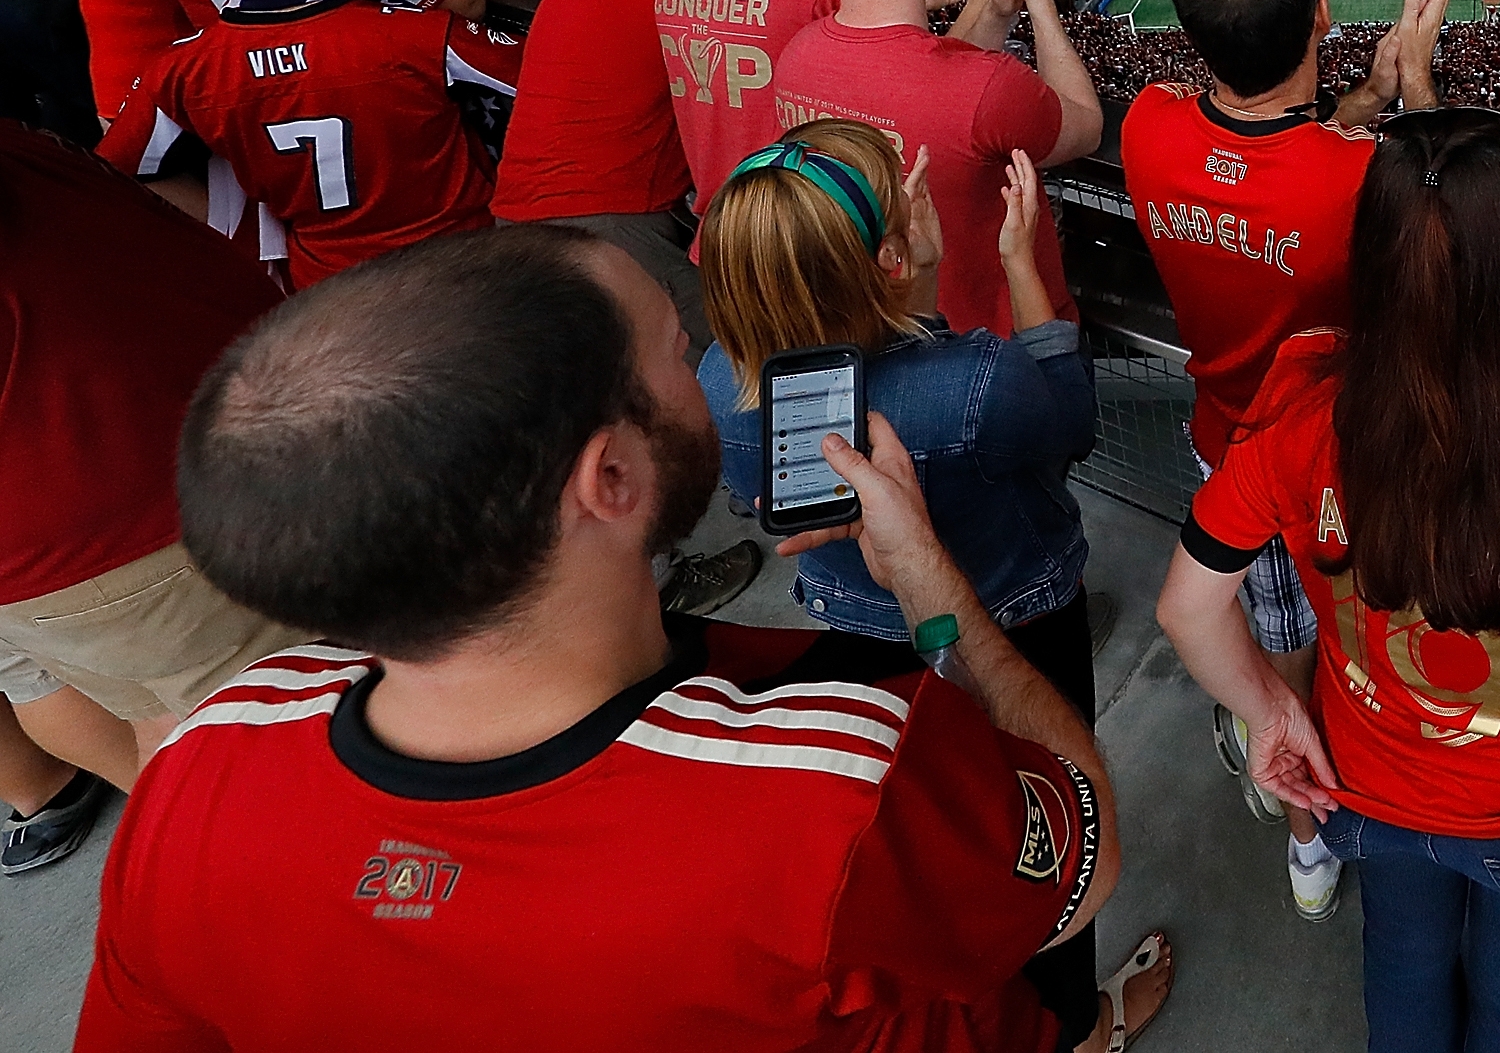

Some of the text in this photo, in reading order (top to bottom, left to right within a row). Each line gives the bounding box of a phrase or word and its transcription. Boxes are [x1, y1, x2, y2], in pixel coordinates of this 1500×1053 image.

[691, 23, 708, 34] THE
[247, 44, 308, 78] VICK
[794, 93, 812, 104] UNITED
[835, 104, 847, 114] MLS
[848, 109, 859, 118] CUP
[861, 112, 895, 127] PLAYOFFS
[775, 96, 906, 164] CONR
[264, 116, 353, 212] 7
[1205, 156, 1247, 180] 2017
[1213, 175, 1237, 185] SEASON
[1024, 806, 1041, 865] MLS
[354, 856, 462, 901] 2017
[373, 904, 434, 919] SEASON
